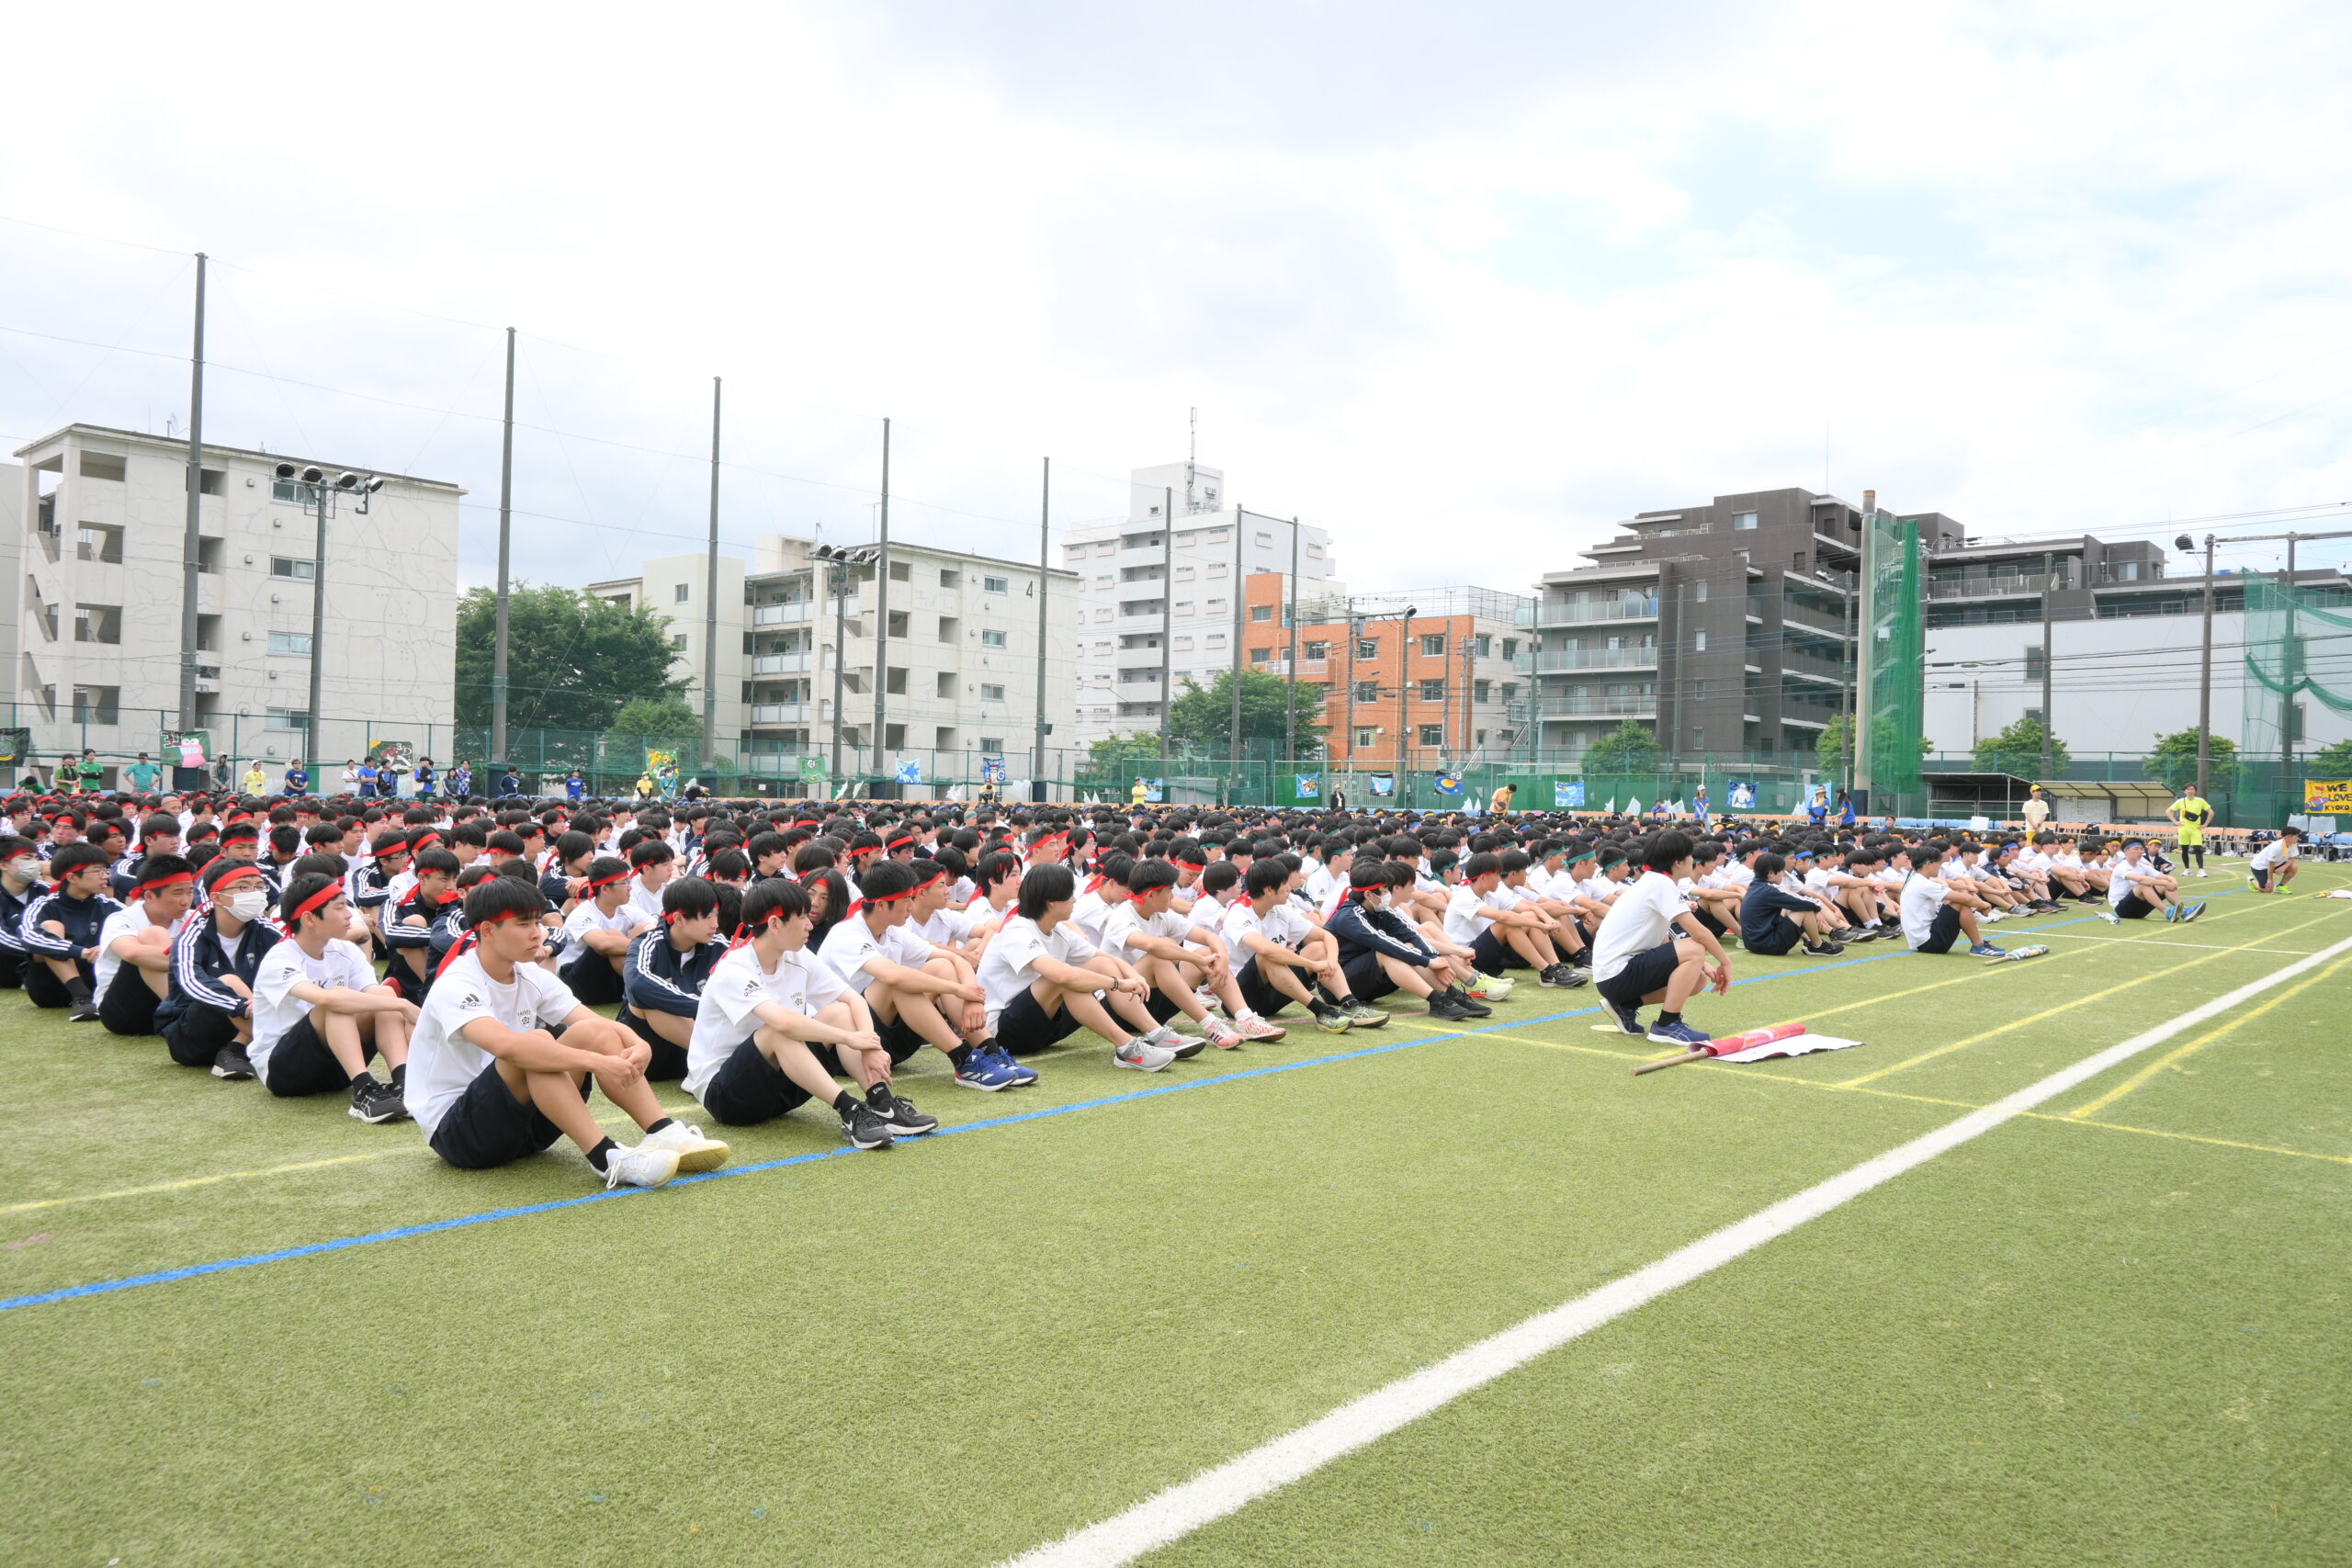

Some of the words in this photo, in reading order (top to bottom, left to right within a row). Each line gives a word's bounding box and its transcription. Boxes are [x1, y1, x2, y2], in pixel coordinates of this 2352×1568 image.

[1025, 580, 1033, 599] 4
[2326, 783, 2348, 793] WE
[2328, 793, 2352, 802] LOVE
